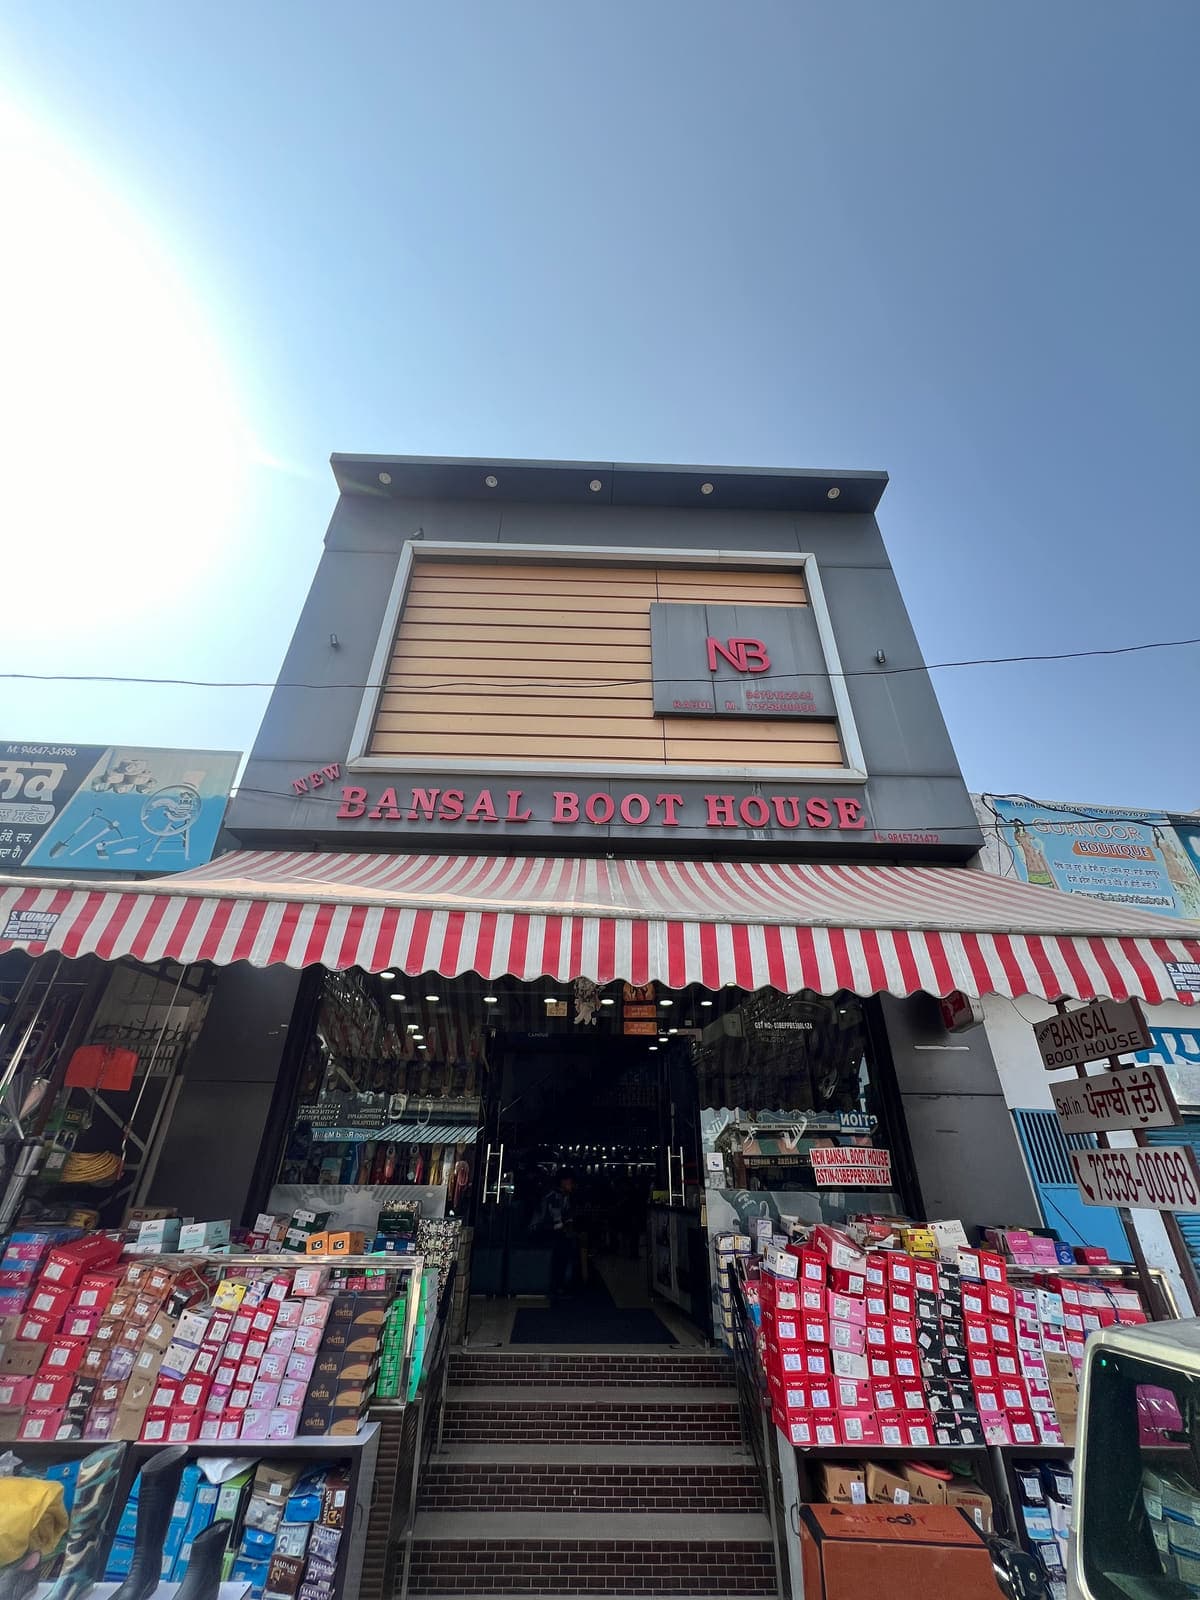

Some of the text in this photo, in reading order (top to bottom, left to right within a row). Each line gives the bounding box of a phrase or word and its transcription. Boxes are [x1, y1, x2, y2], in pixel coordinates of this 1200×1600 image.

[706, 636, 771, 672] NB
[673, 701, 713, 710] RAHUL
[292, 762, 341, 795] NEW
[336, 786, 866, 830] BANSAL BOOT HOUSE
[1032, 818, 1144, 842] GURNOOR
[1079, 841, 1149, 859] BOUTIQUE
[20, 912, 59, 923] KUMAR
[1050, 1006, 1117, 1048] BANSAL
[1046, 1046, 1080, 1066] BOOT
[1084, 1031, 1140, 1057] HOUSE
[1083, 1077, 1130, 1118] ਪੰਜਾਬੀ
[811, 1150, 825, 1164] NEW
[825, 1149, 849, 1164] BANSAL
[849, 1149, 866, 1164] BOOT
[867, 1150, 889, 1166] HOUSE
[1088, 1151, 1197, 1205] 73558-00098
